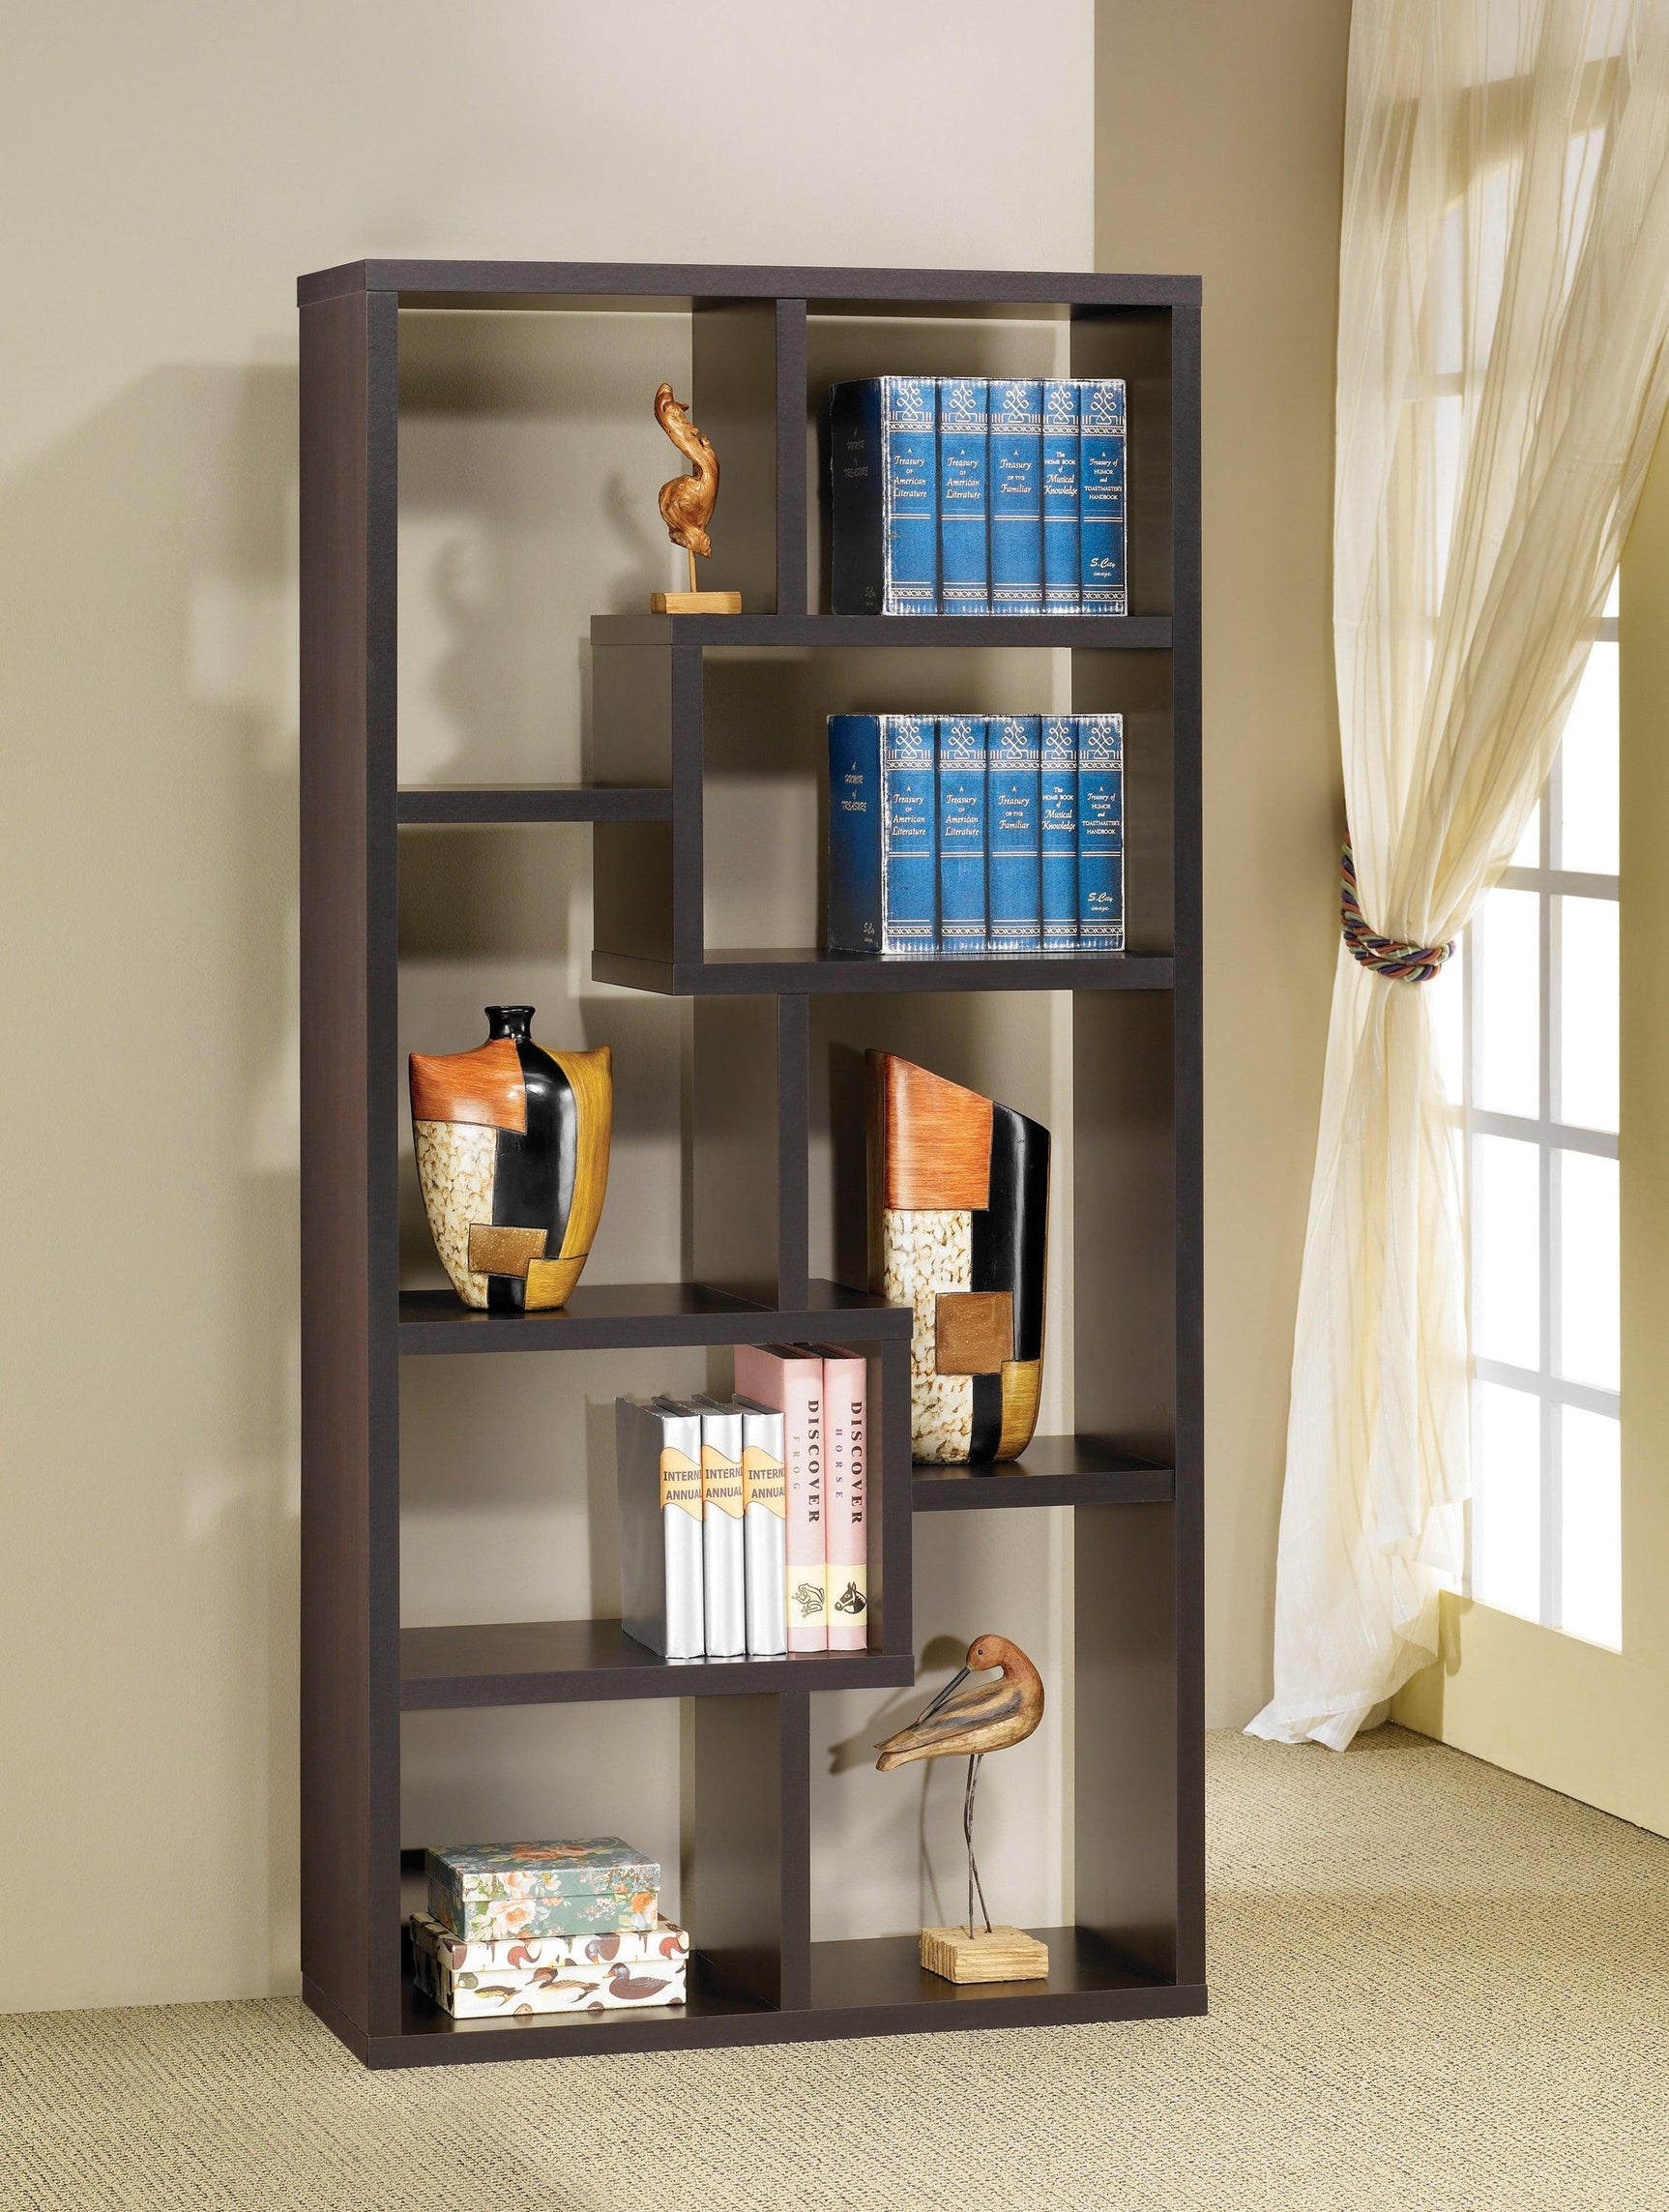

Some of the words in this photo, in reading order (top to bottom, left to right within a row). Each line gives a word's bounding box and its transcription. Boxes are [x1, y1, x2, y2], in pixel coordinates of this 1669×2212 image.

[894, 456, 925, 467] Treasury
[948, 457, 979, 468] Treasury
[1000, 458, 1032, 471] Treasury
[1089, 458, 1111, 467] Treasury
[893, 476, 926, 486] American
[947, 478, 980, 487] American
[1046, 474, 1074, 484] Musical
[893, 487, 927, 498] Literature
[946, 488, 981, 499] Literature
[1001, 484, 1031, 493] Familiar
[1043, 486, 1078, 497] Knowledge
[893, 793, 924, 805] Treasury
[946, 794, 978, 806] Treasury
[998, 795, 1030, 807] Treasury
[1087, 793, 1109, 802] Treasury
[893, 814, 925, 823] American
[945, 814, 979, 824] American
[1044, 809, 1072, 819] Musical
[999, 819, 1030, 830] Familiar
[1041, 820, 1075, 832] Knowledge
[892, 826, 926, 836] Literature
[944, 826, 980, 837] Literature
[792, 1435, 801, 1489] FROG
[807, 1400, 820, 1523] DISCOVER
[834, 1429, 843, 1498] HORSE
[851, 1401, 863, 1524] DISCOVER
[666, 1489, 702, 1500] ANNUAL
[706, 1486, 742, 1498] ANNUAL
